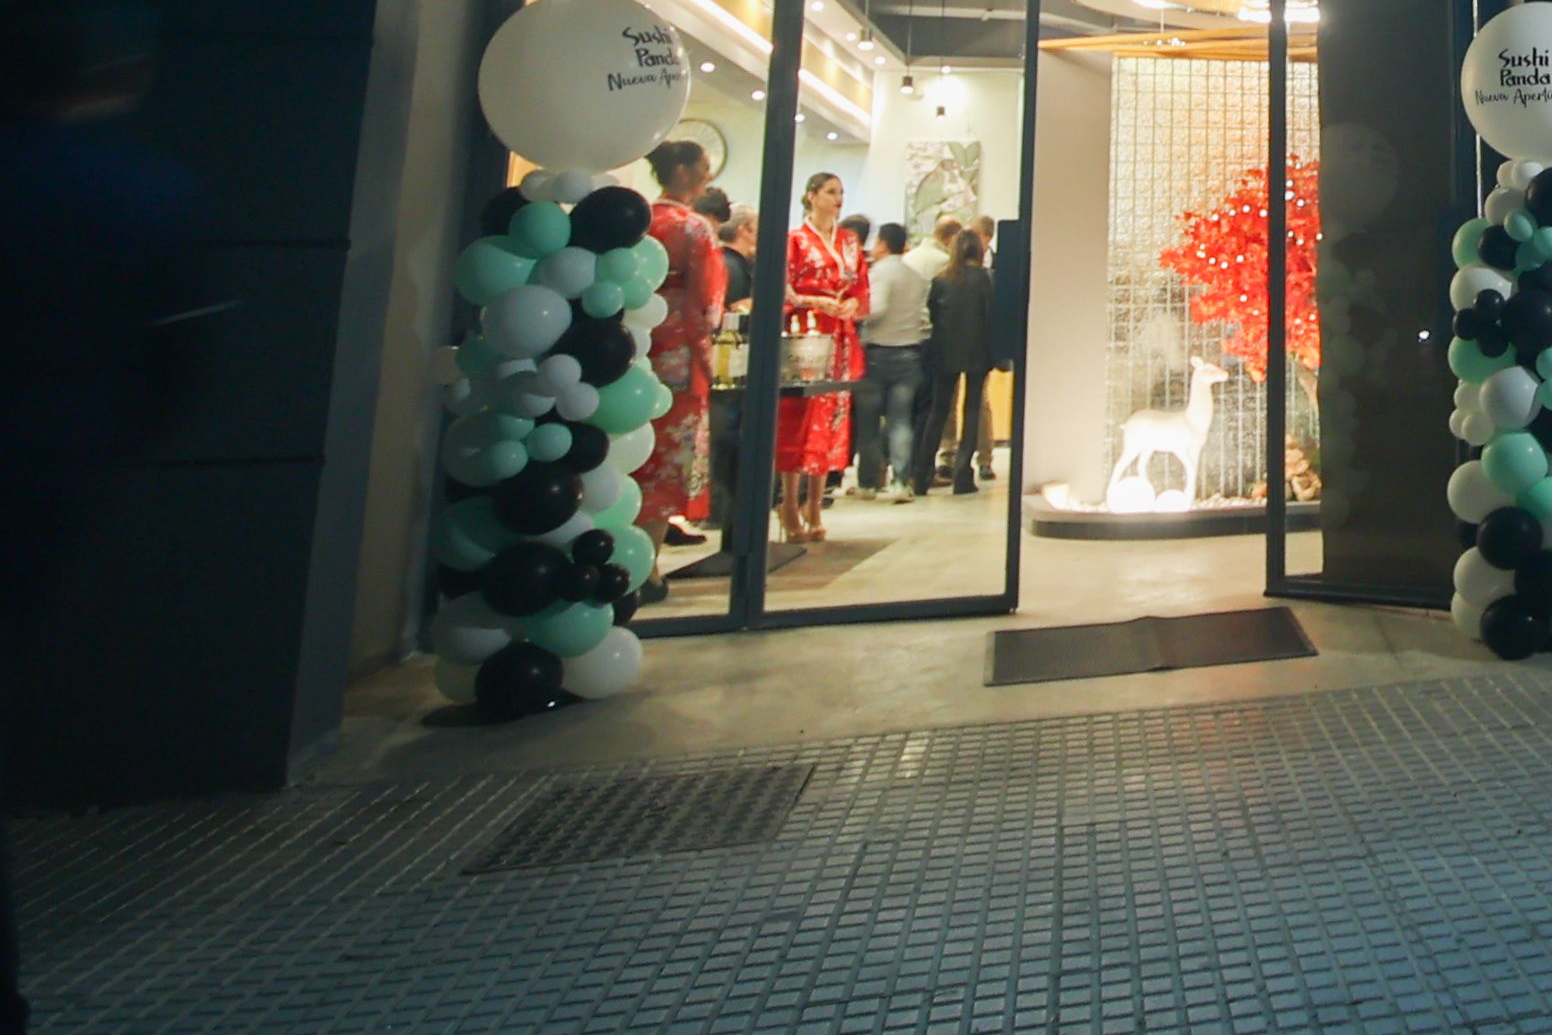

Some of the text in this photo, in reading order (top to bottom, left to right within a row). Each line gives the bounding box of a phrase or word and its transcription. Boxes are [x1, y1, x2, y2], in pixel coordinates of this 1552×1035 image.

[1498, 47, 1549, 68] Sushi
[607, 72, 656, 91] Nueva
[1500, 68, 1551, 87] Panda
